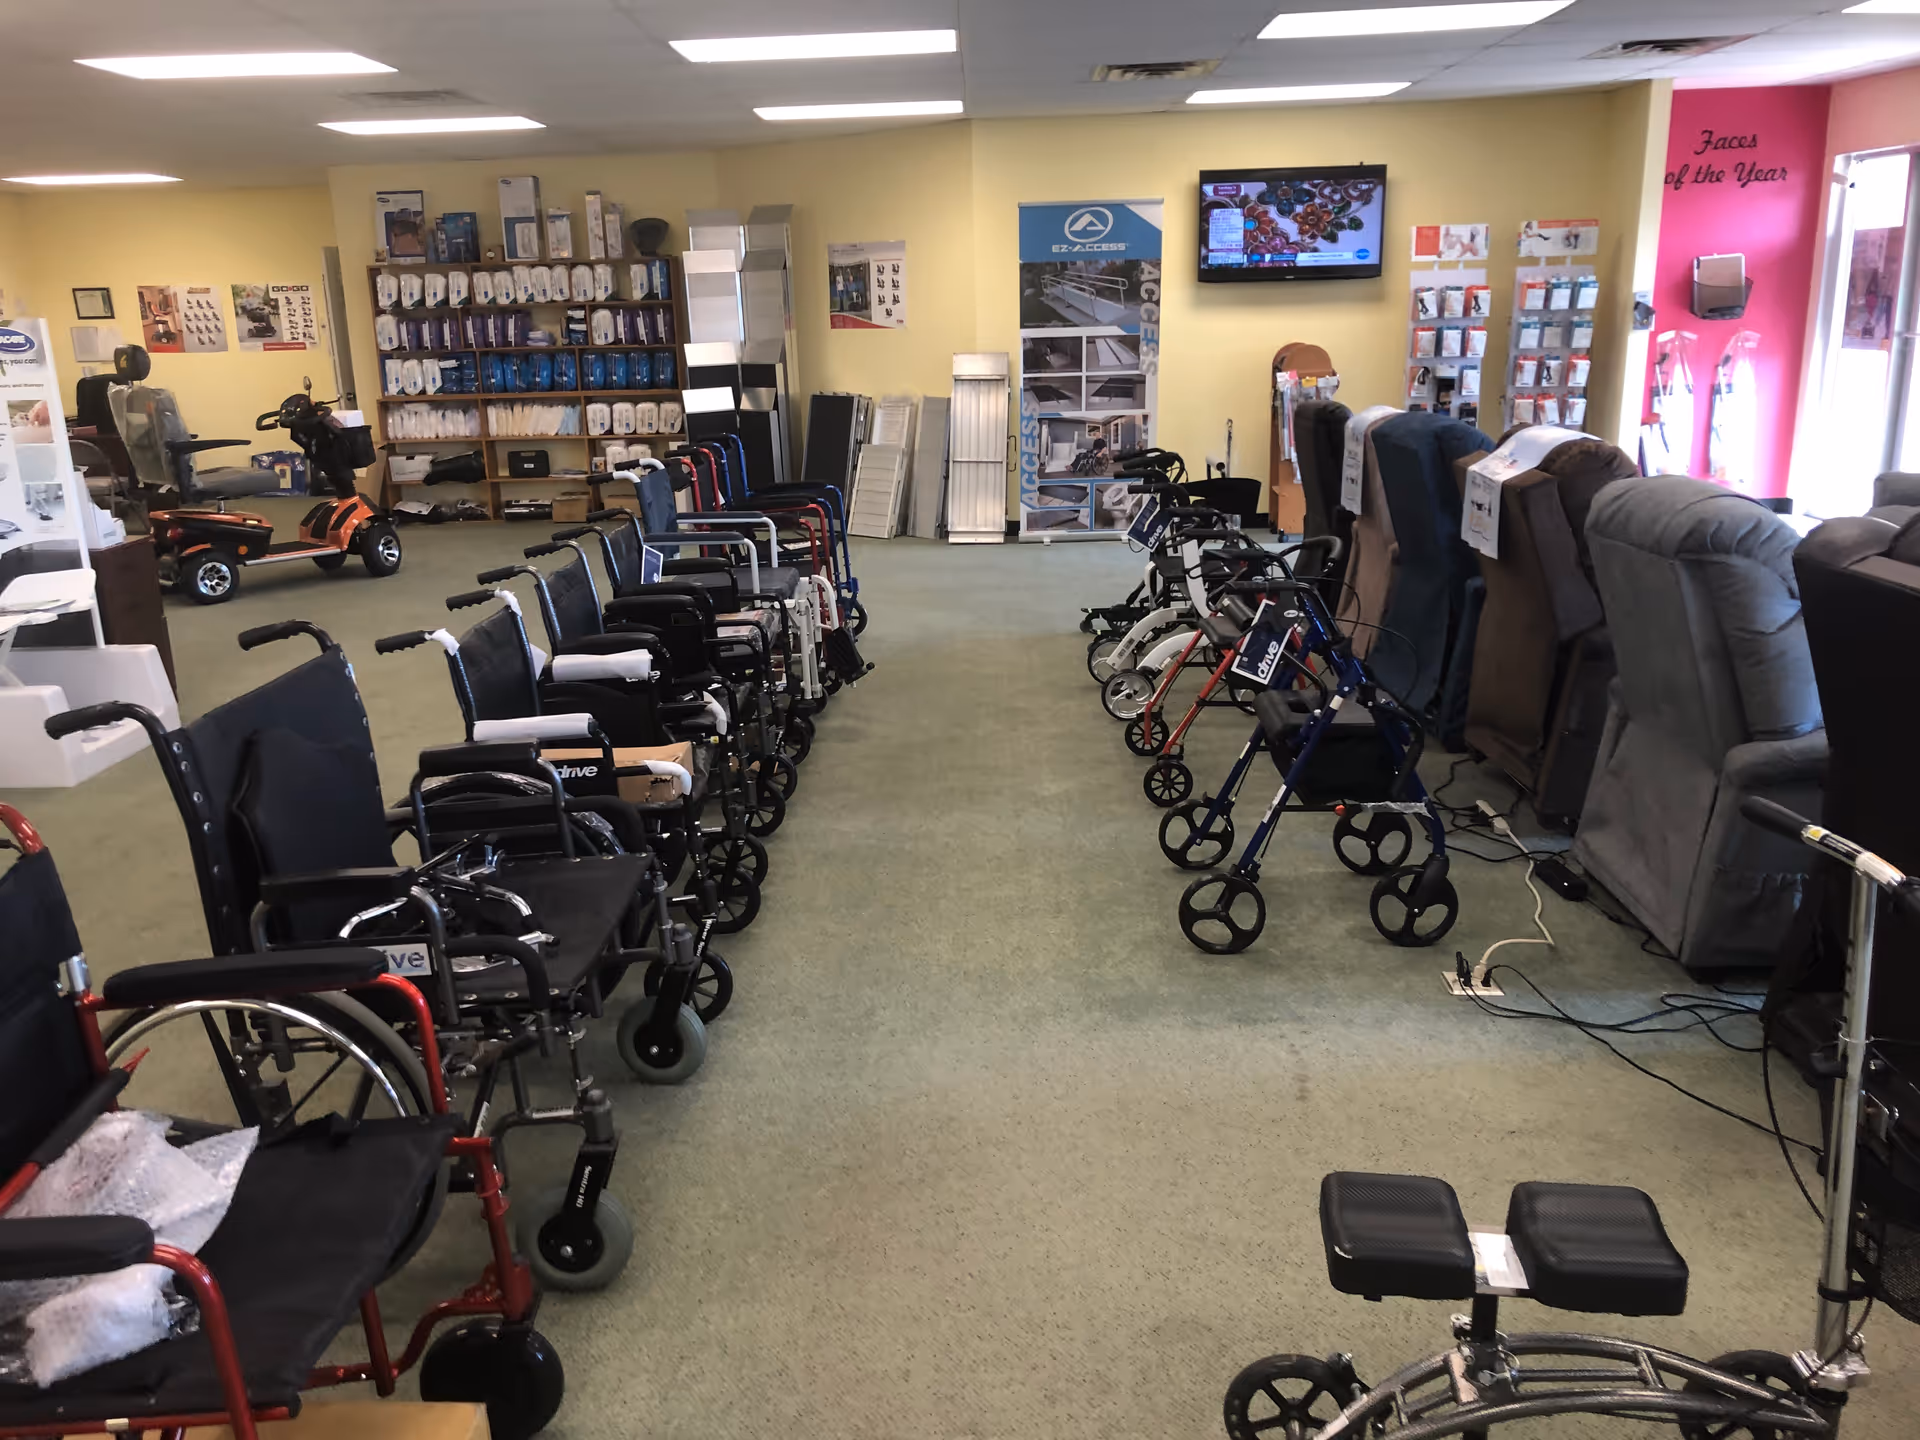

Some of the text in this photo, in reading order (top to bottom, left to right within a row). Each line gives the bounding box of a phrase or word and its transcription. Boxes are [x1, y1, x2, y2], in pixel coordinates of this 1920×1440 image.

[1694, 129, 1758, 155] Faces
[1664, 161, 1788, 191] of the Year
[1051, 243, 1126, 253] EZ-ACCESS
[1139, 261, 1160, 375] ACCESS
[1021, 401, 1040, 508] ACCESS
[1147, 524, 1164, 548] drive
[1257, 641, 1280, 679] drive
[556, 765, 599, 779] drive
